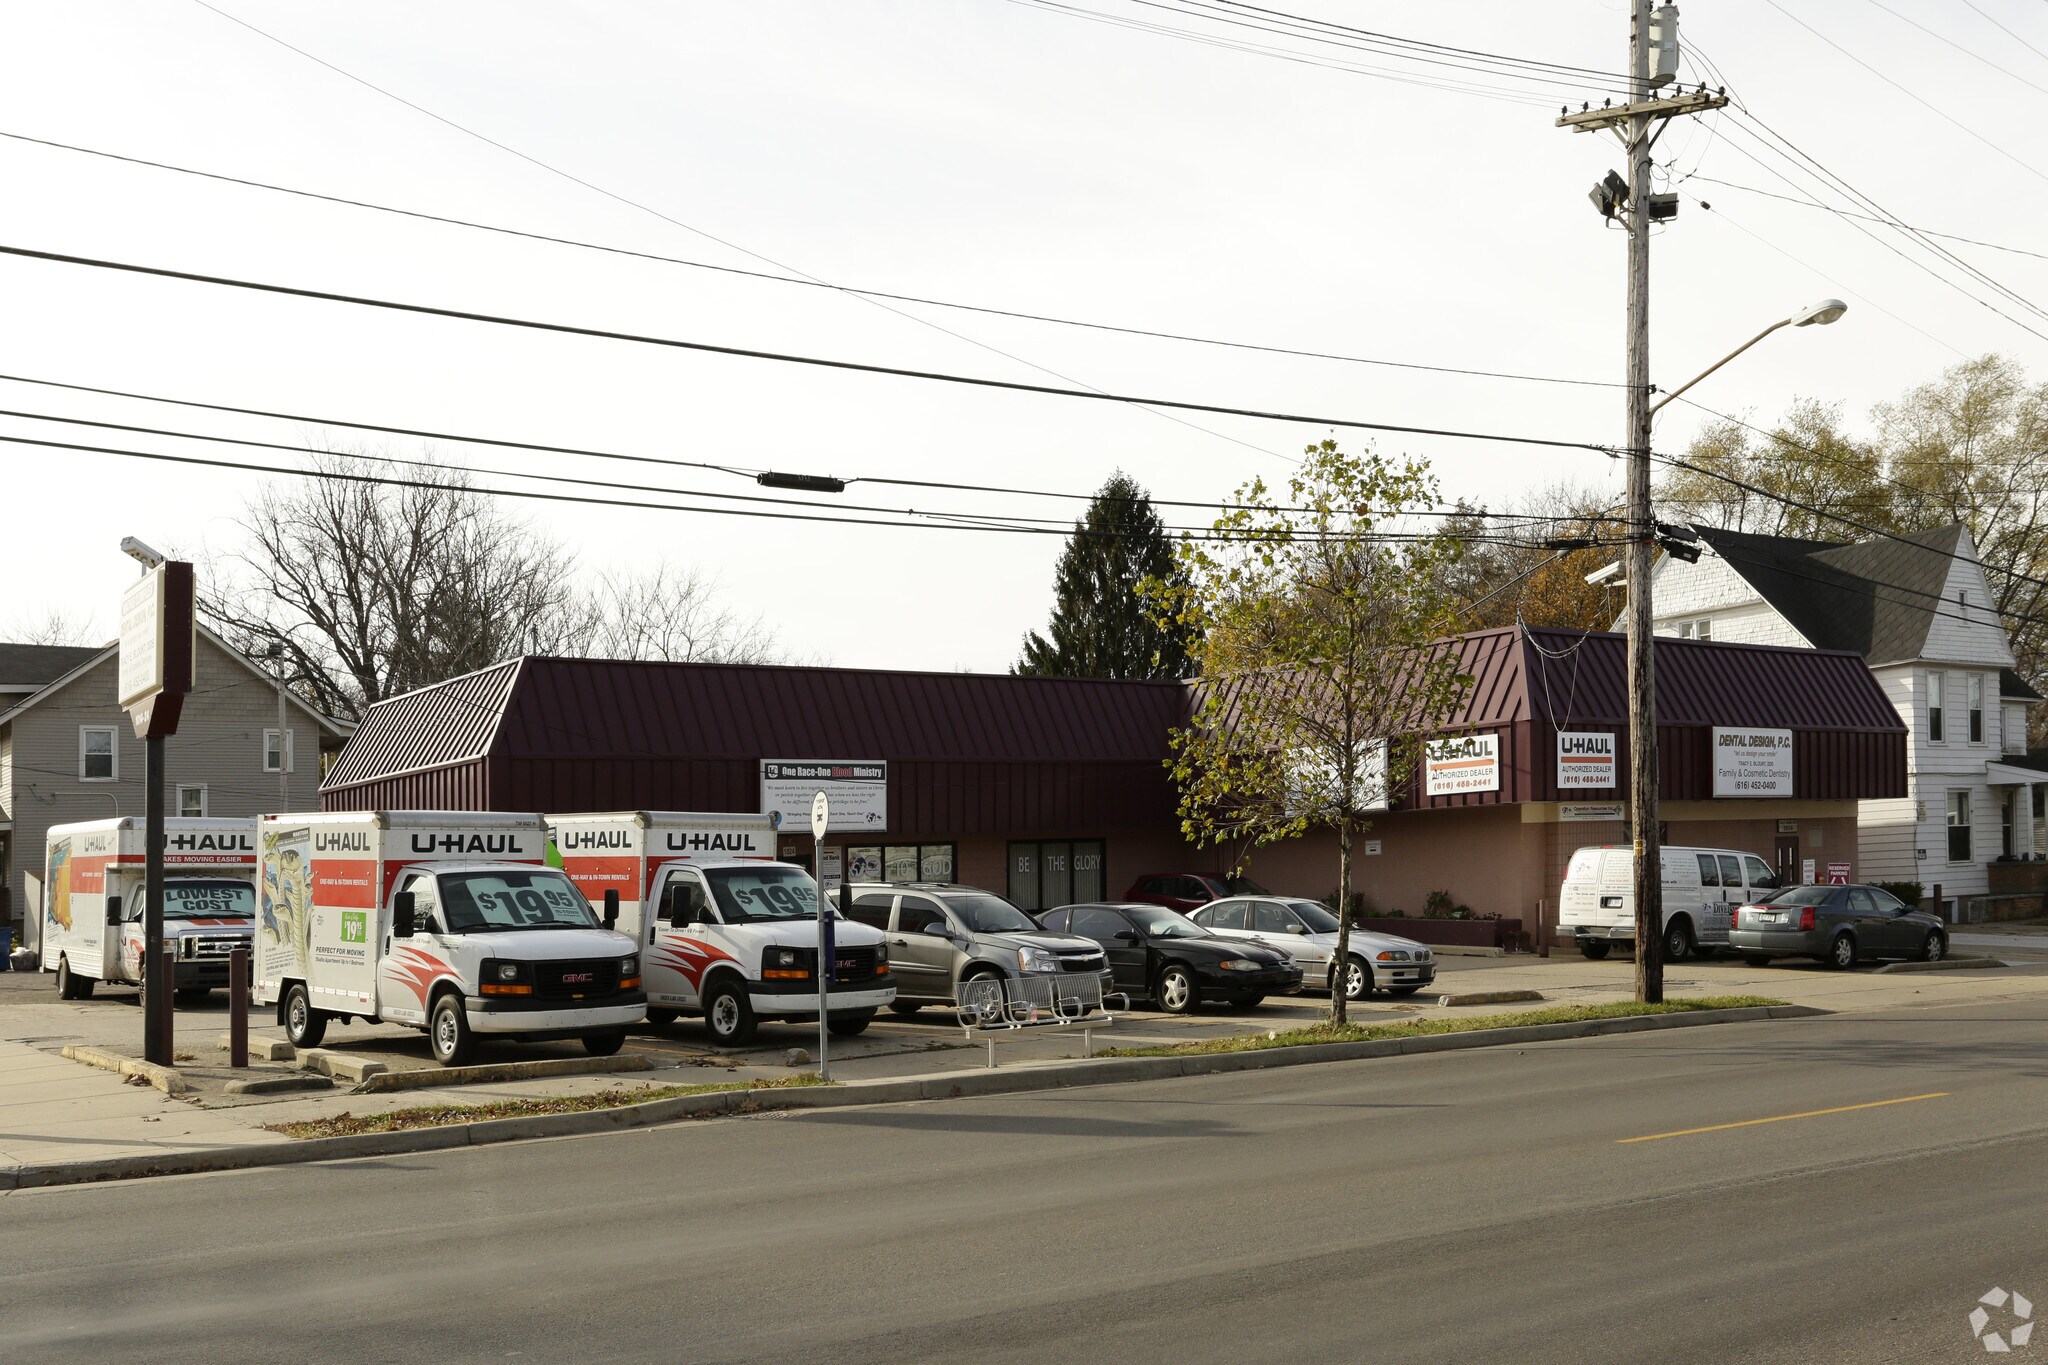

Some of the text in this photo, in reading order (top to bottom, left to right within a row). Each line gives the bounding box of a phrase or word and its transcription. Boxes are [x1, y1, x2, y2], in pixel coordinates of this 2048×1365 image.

[1562, 738, 1611, 754] U-HAUL
[1719, 735, 1790, 749] DENTAL DESIGN, P.C.
[782, 766, 882, 778] One Race-One Blood Ministry
[1432, 768, 1493, 780] AUTHORIZED DEALER
[1719, 769, 1790, 779] Family & Cosmetic Dentistry
[1735, 781, 1750, 790] (616)
[84, 836, 106, 852] U-HAUL
[164, 834, 253, 850] -HAUL
[316, 832, 370, 851] U-HAUL
[412, 834, 523, 853] U-HAUL
[565, 831, 632, 849] U-HAUL
[667, 833, 756, 851] U-HAUL
[923, 859, 951, 876] GOD
[1018, 855, 1101, 872] BE THE GLORY
[165, 888, 242, 902] LOWEST
[183, 900, 232, 910] COST
[563, 973, 593, 983] GMC
